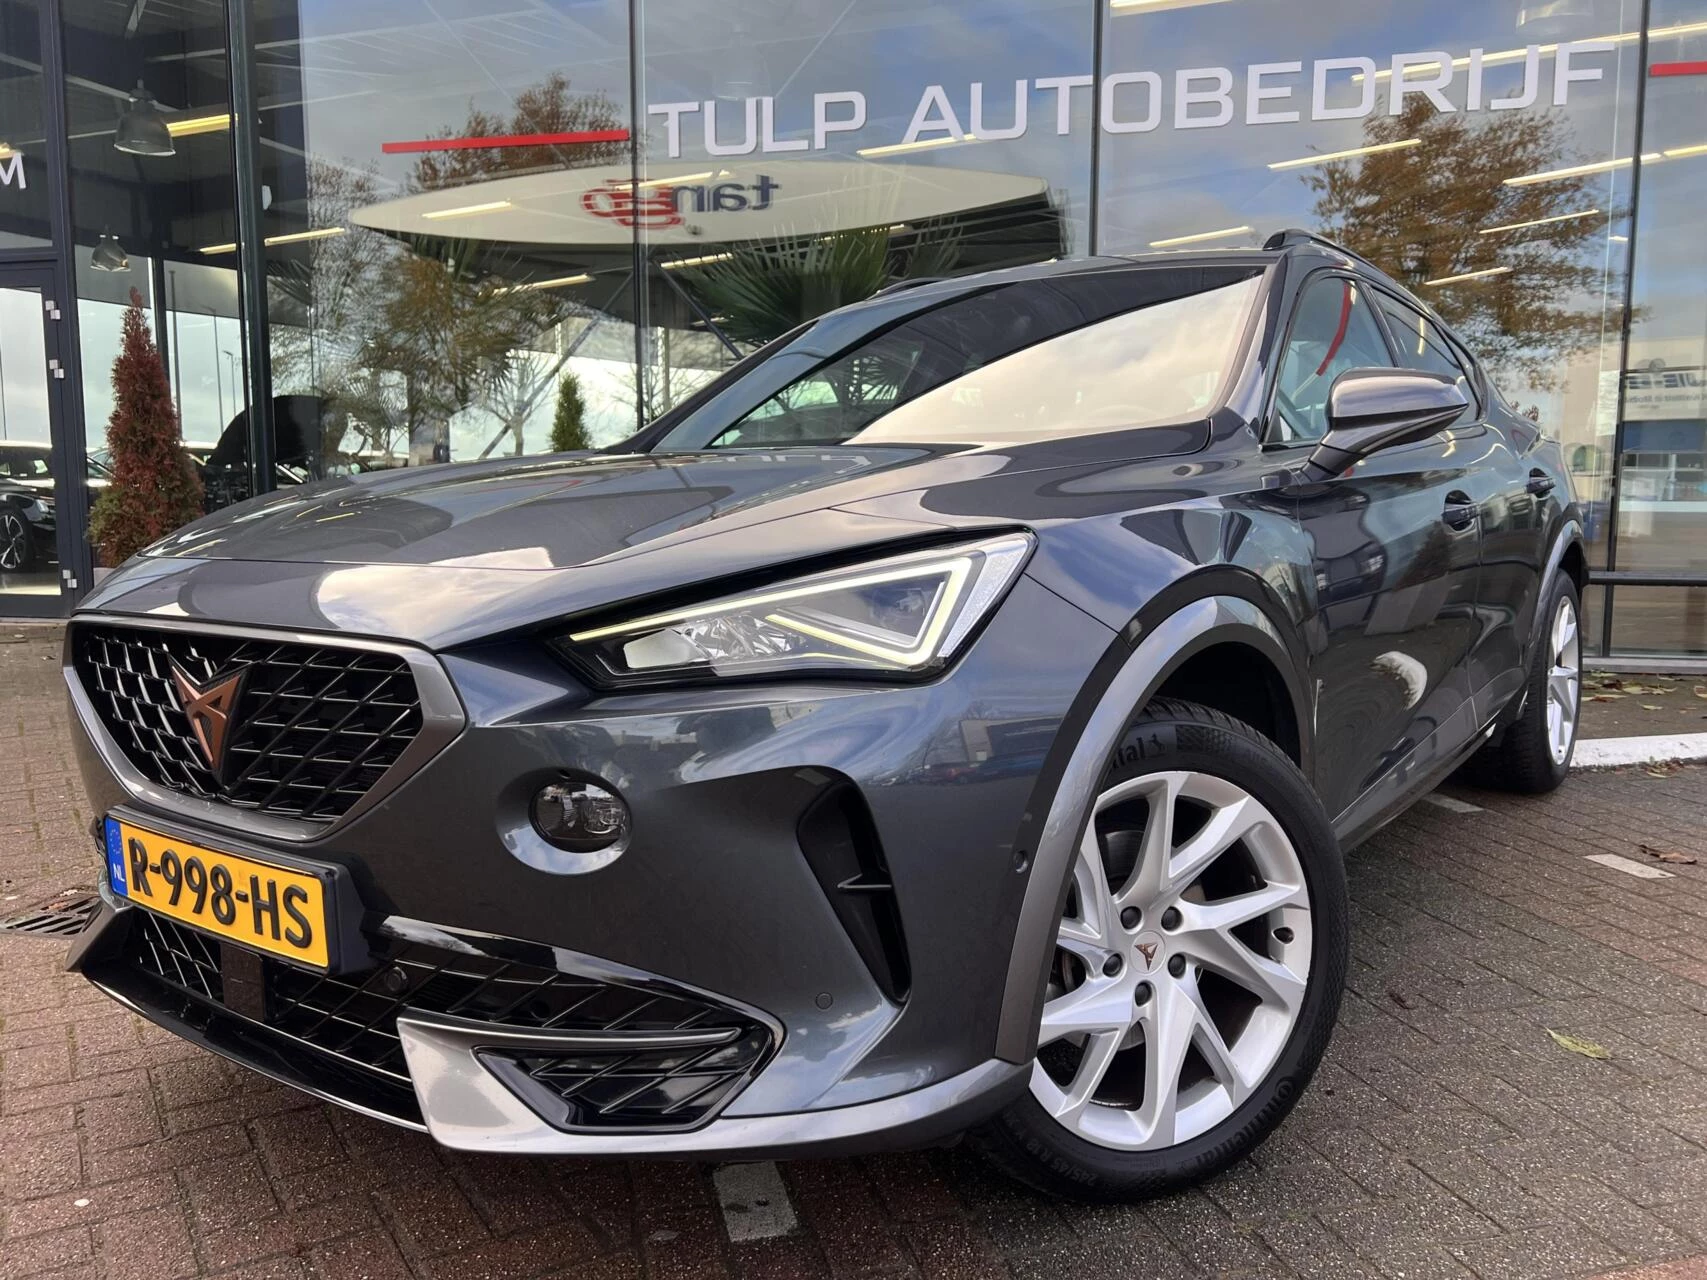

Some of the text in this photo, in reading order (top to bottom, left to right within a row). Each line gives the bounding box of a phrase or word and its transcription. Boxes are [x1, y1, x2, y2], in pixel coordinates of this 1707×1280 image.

[648, 41, 1615, 158] TULP AUTOBEDRIJF
[113, 863, 126, 883] NL
[128, 836, 313, 949] R-998-HS
